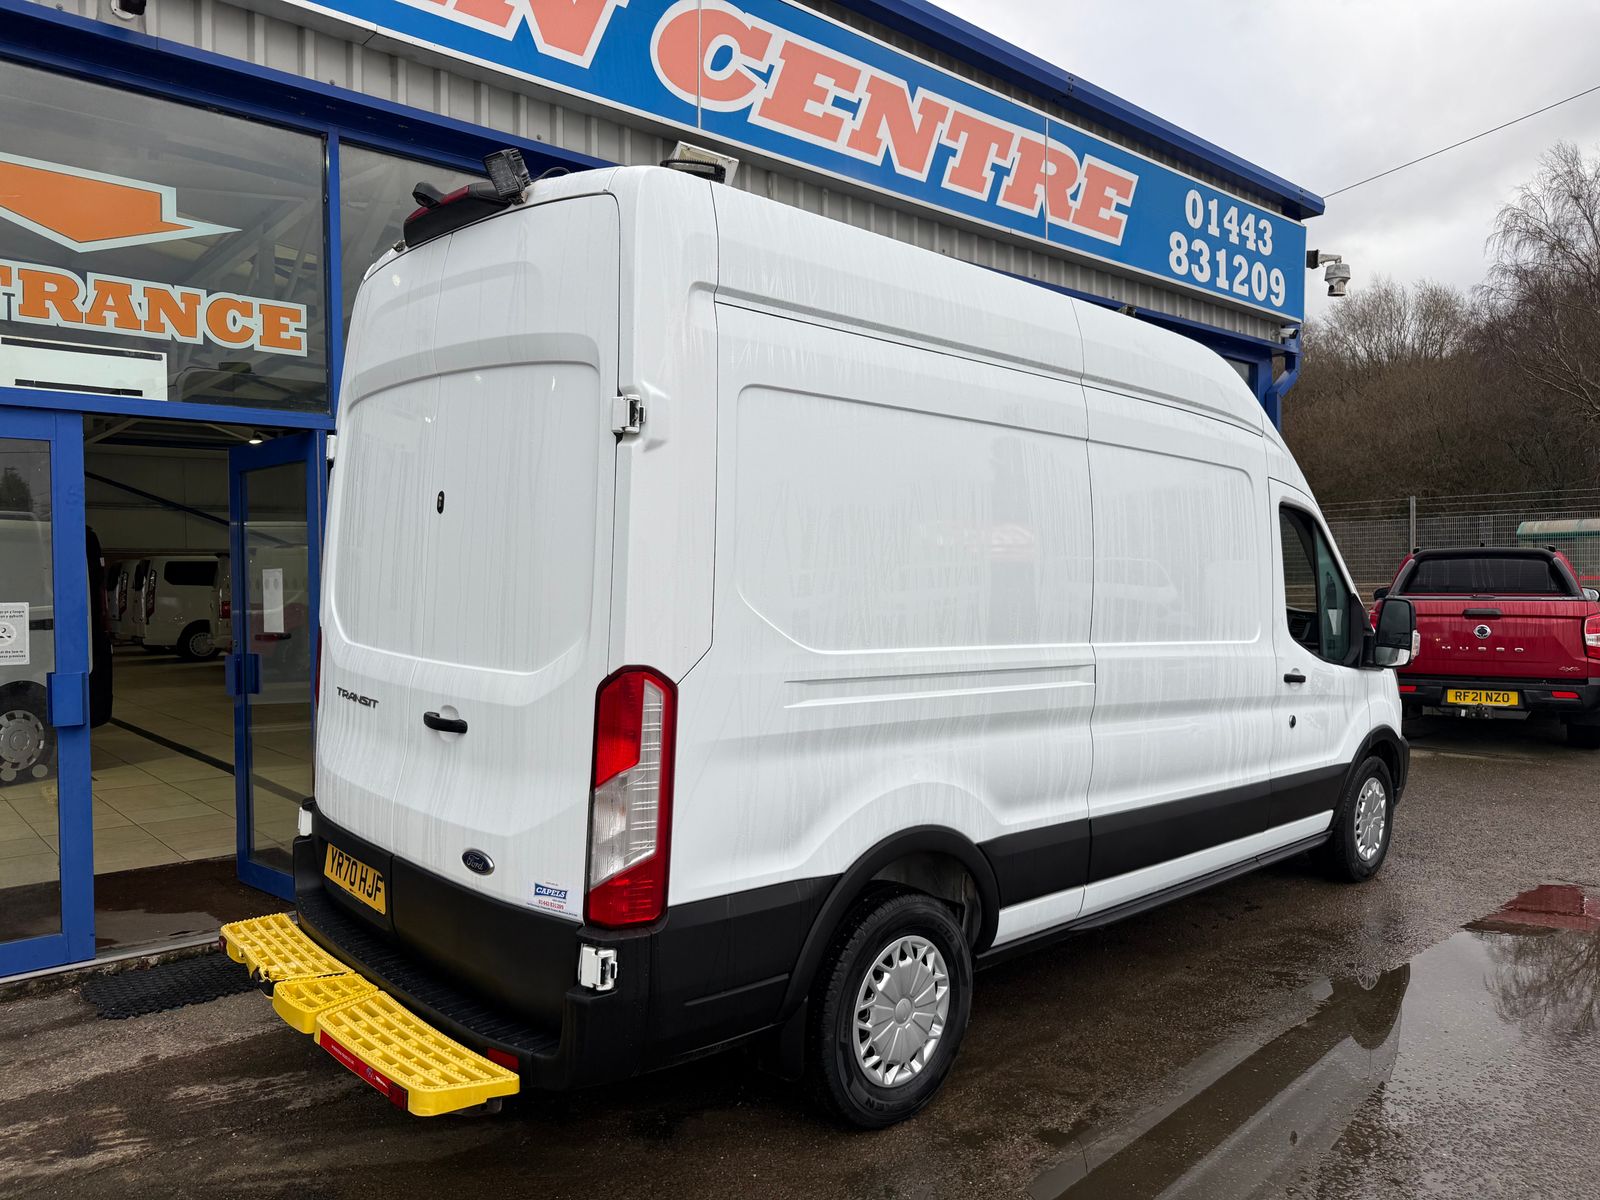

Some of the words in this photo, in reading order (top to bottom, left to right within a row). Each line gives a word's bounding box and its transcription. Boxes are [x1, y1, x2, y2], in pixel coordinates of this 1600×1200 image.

[651, 1, 1139, 245] CENTRE
[1185, 189, 1273, 256] 01443
[1168, 231, 1286, 307] 831209
[337, 686, 379, 708] TRANSIT
[1455, 690, 1482, 702] RF21
[331, 847, 358, 887] YR70
[358, 864, 383, 901] HJF
[536, 886, 566, 898] CAPELS
